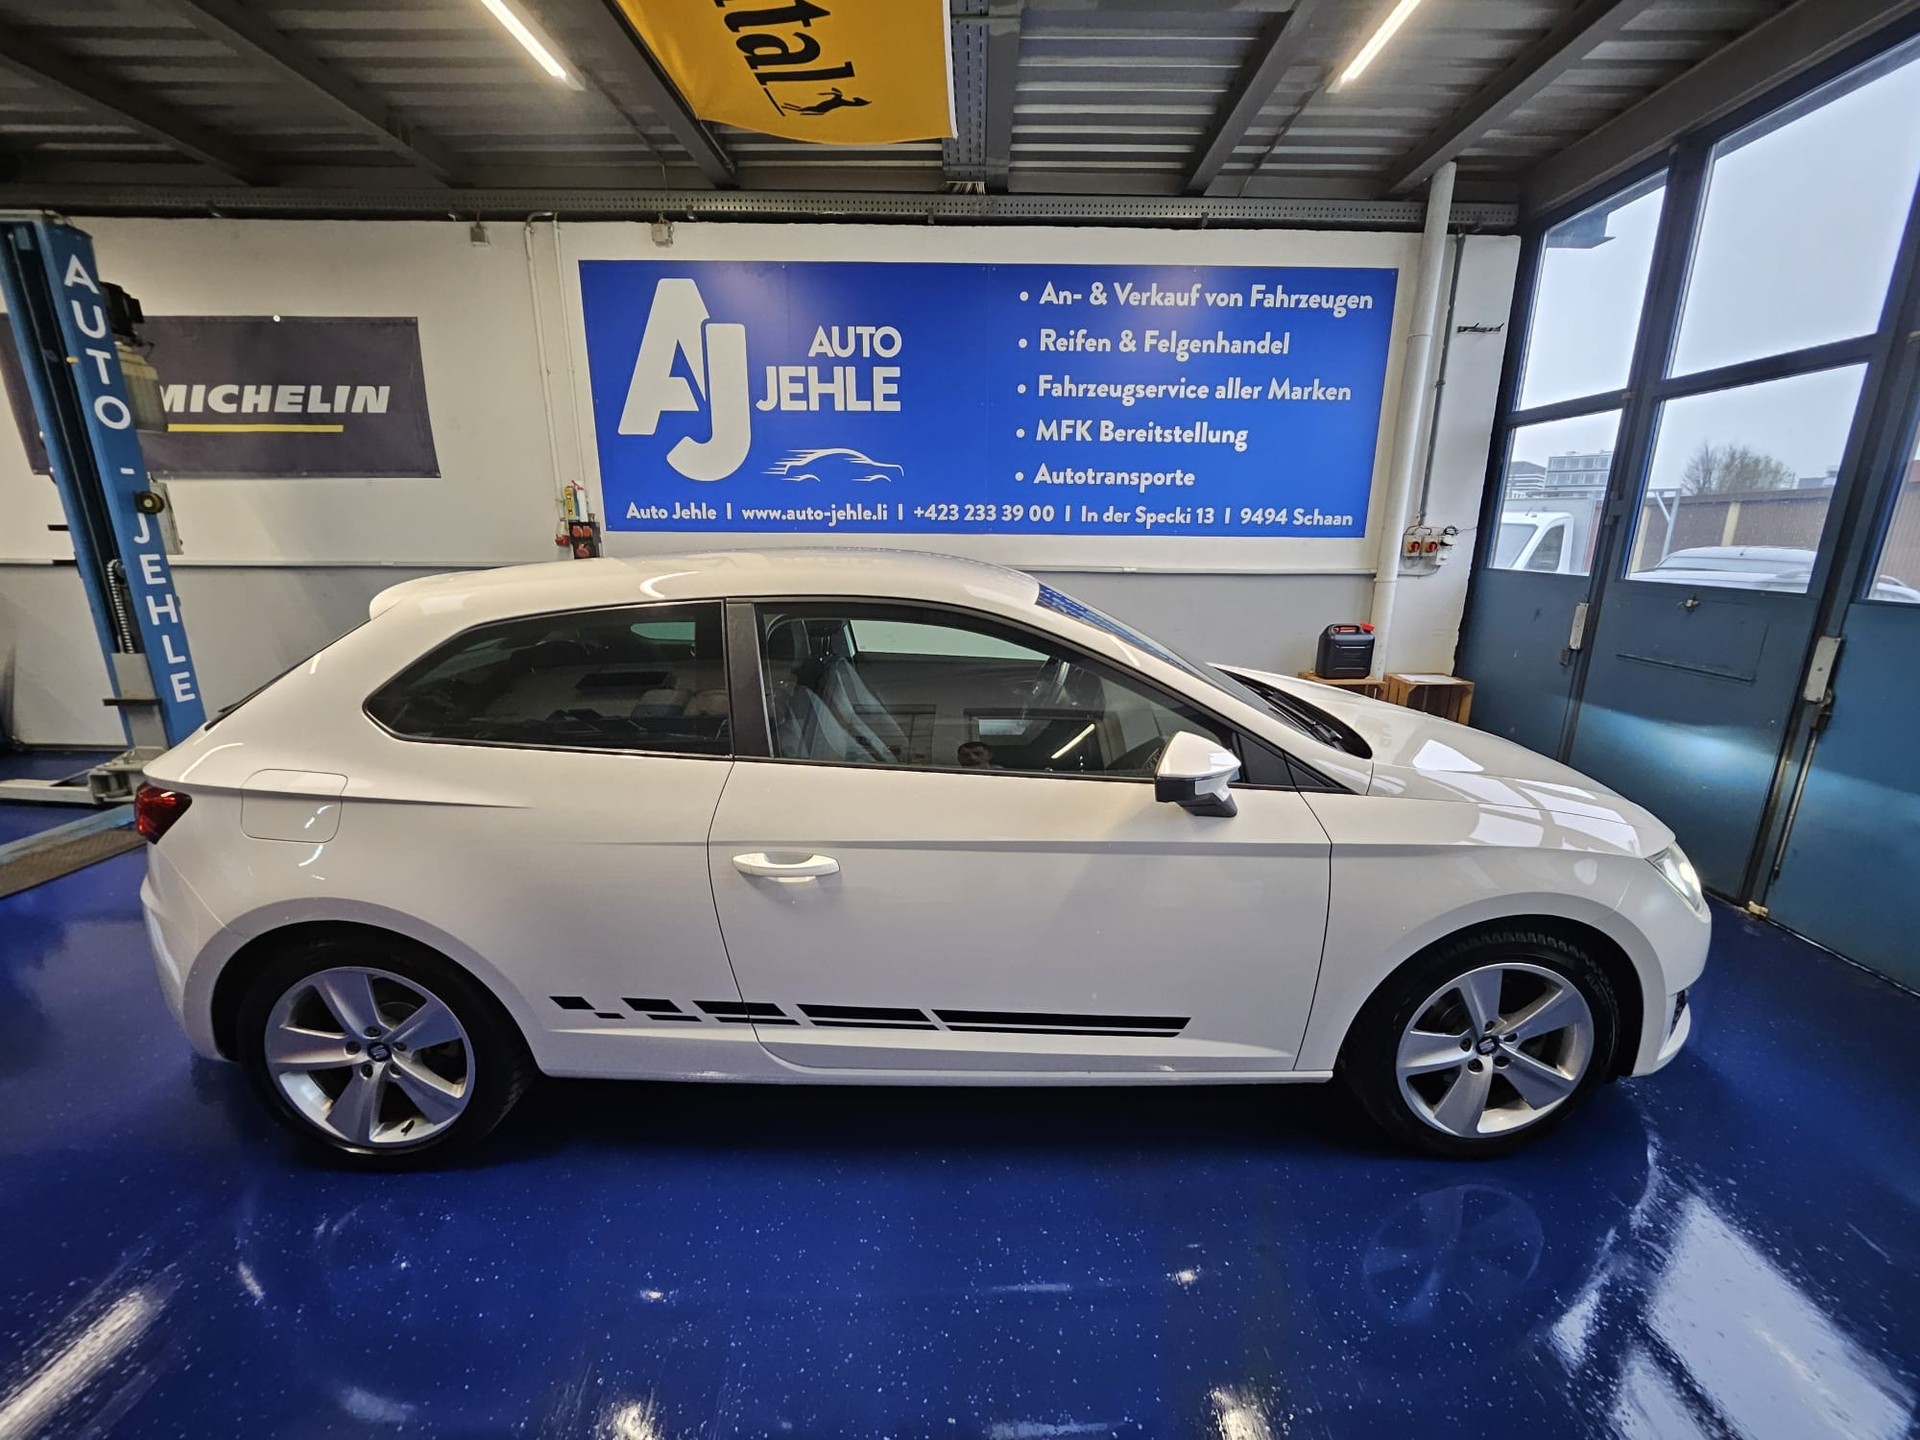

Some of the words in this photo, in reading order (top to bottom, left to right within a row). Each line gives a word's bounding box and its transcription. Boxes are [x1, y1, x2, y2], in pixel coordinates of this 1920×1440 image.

[713, 0, 856, 86] tal
[1039, 281, 1082, 305] An-
[1089, 281, 1108, 306] &
[1113, 282, 1202, 307] Verkauf
[1204, 292, 1243, 307] von
[1250, 284, 1373, 318] Fahrzeugen
[807, 325, 903, 358] AUTO
[1040, 328, 1112, 352] Reifen
[1118, 329, 1137, 353] &
[1143, 329, 1291, 362] Felgenhandel
[617, 277, 752, 482] AJ
[755, 365, 901, 412] JEHLE
[1038, 374, 1210, 407] Fahrzeugservice
[1214, 376, 1263, 400] aller
[1267, 377, 1351, 401] Marken
[160, 384, 391, 414] MICHELIN
[1036, 419, 1093, 442] MFK
[1099, 420, 1249, 452] Bereitstellung
[1033, 462, 1196, 493] Autotransporte
[626, 502, 668, 520] Auto
[672, 502, 717, 520] Jehle
[741, 503, 888, 527] www.auto-jehle.li
[913, 503, 959, 521] +423
[964, 504, 997, 522] 233
[1001, 504, 1024, 522] 39
[1029, 505, 1055, 522] 00
[1081, 505, 1098, 522] In
[1102, 505, 1131, 523] der
[1135, 505, 1192, 530] Specki
[1196, 507, 1215, 524] 13
[1240, 507, 1288, 525] 9494
[1292, 508, 1353, 526] Schaan
